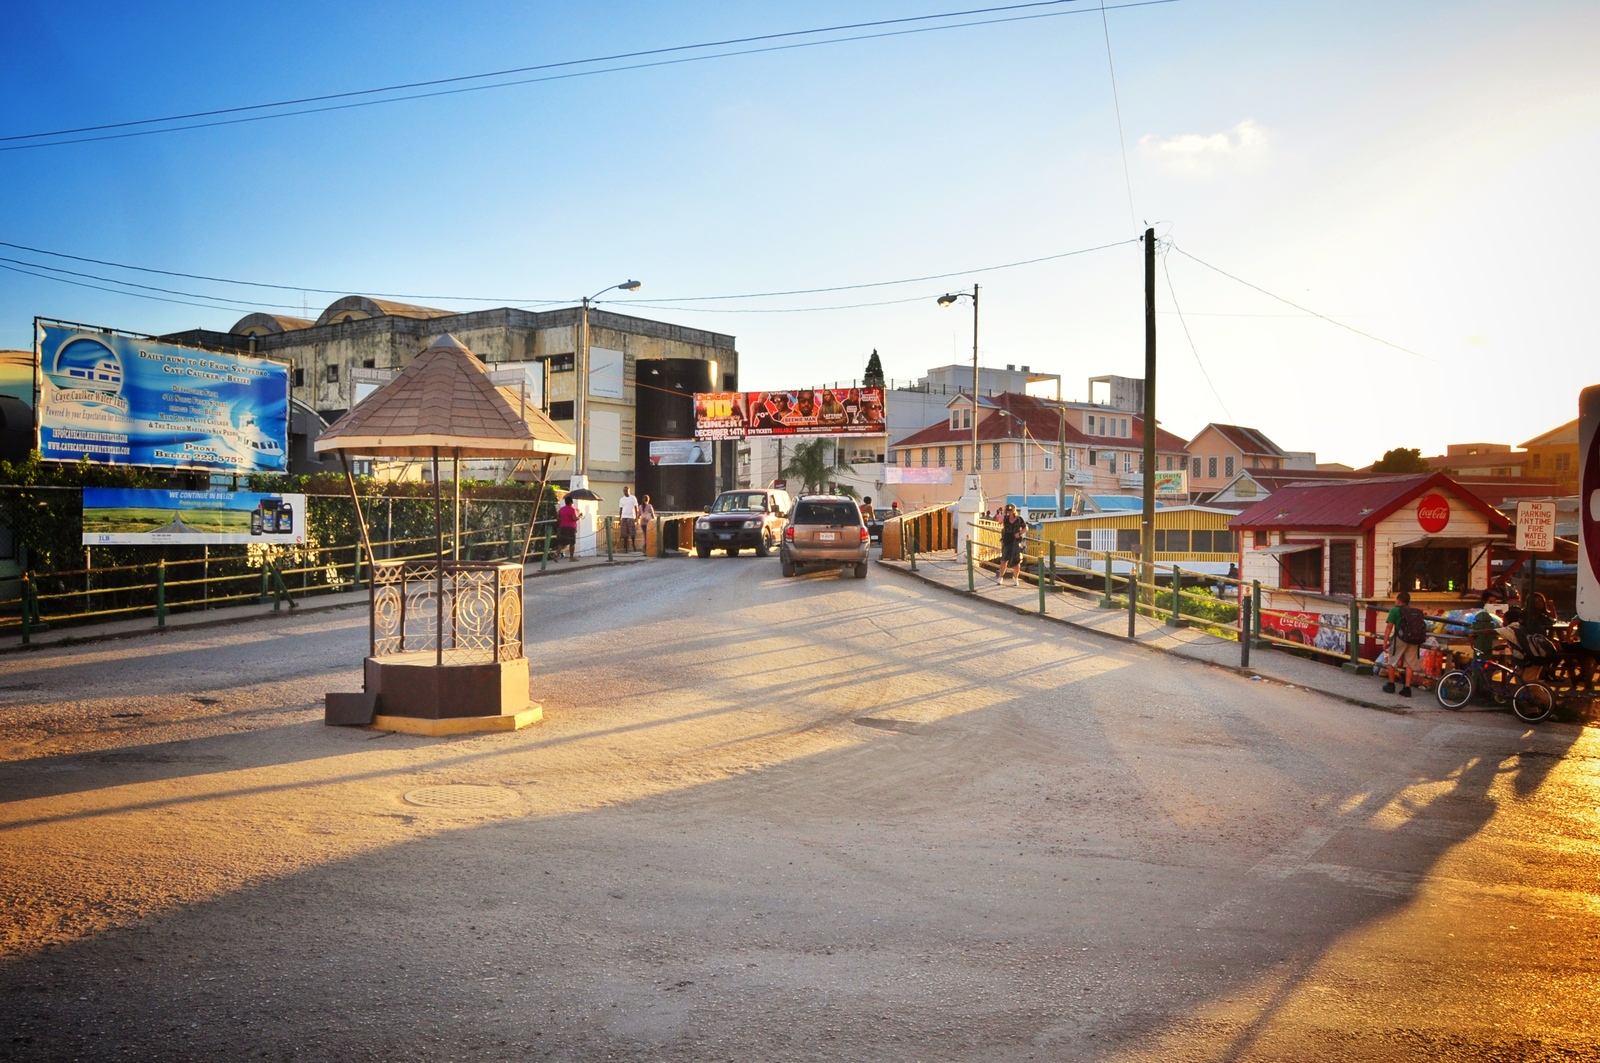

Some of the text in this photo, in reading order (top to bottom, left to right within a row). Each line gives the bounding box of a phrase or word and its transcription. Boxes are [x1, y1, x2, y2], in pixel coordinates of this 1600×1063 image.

[140, 351, 162, 361] DAILY
[210, 362, 229, 370] FROM
[231, 364, 246, 374] SAN
[164, 366, 184, 374] CAYE
[227, 375, 250, 385] BELIZE
[55, 392, 69, 402] Caye
[71, 390, 94, 401] Caulker
[95, 392, 112, 404] Water
[46, 406, 64, 417] Powered
[71, 411, 81, 420] your
[696, 420, 742, 429] CONCERT
[694, 428, 746, 437] DECEMBER 14TH
[184, 442, 217, 452] PHONE
[154, 450, 244, 464] BELIZE 223-5752
[1418, 506, 1448, 519] Coca-Cola
